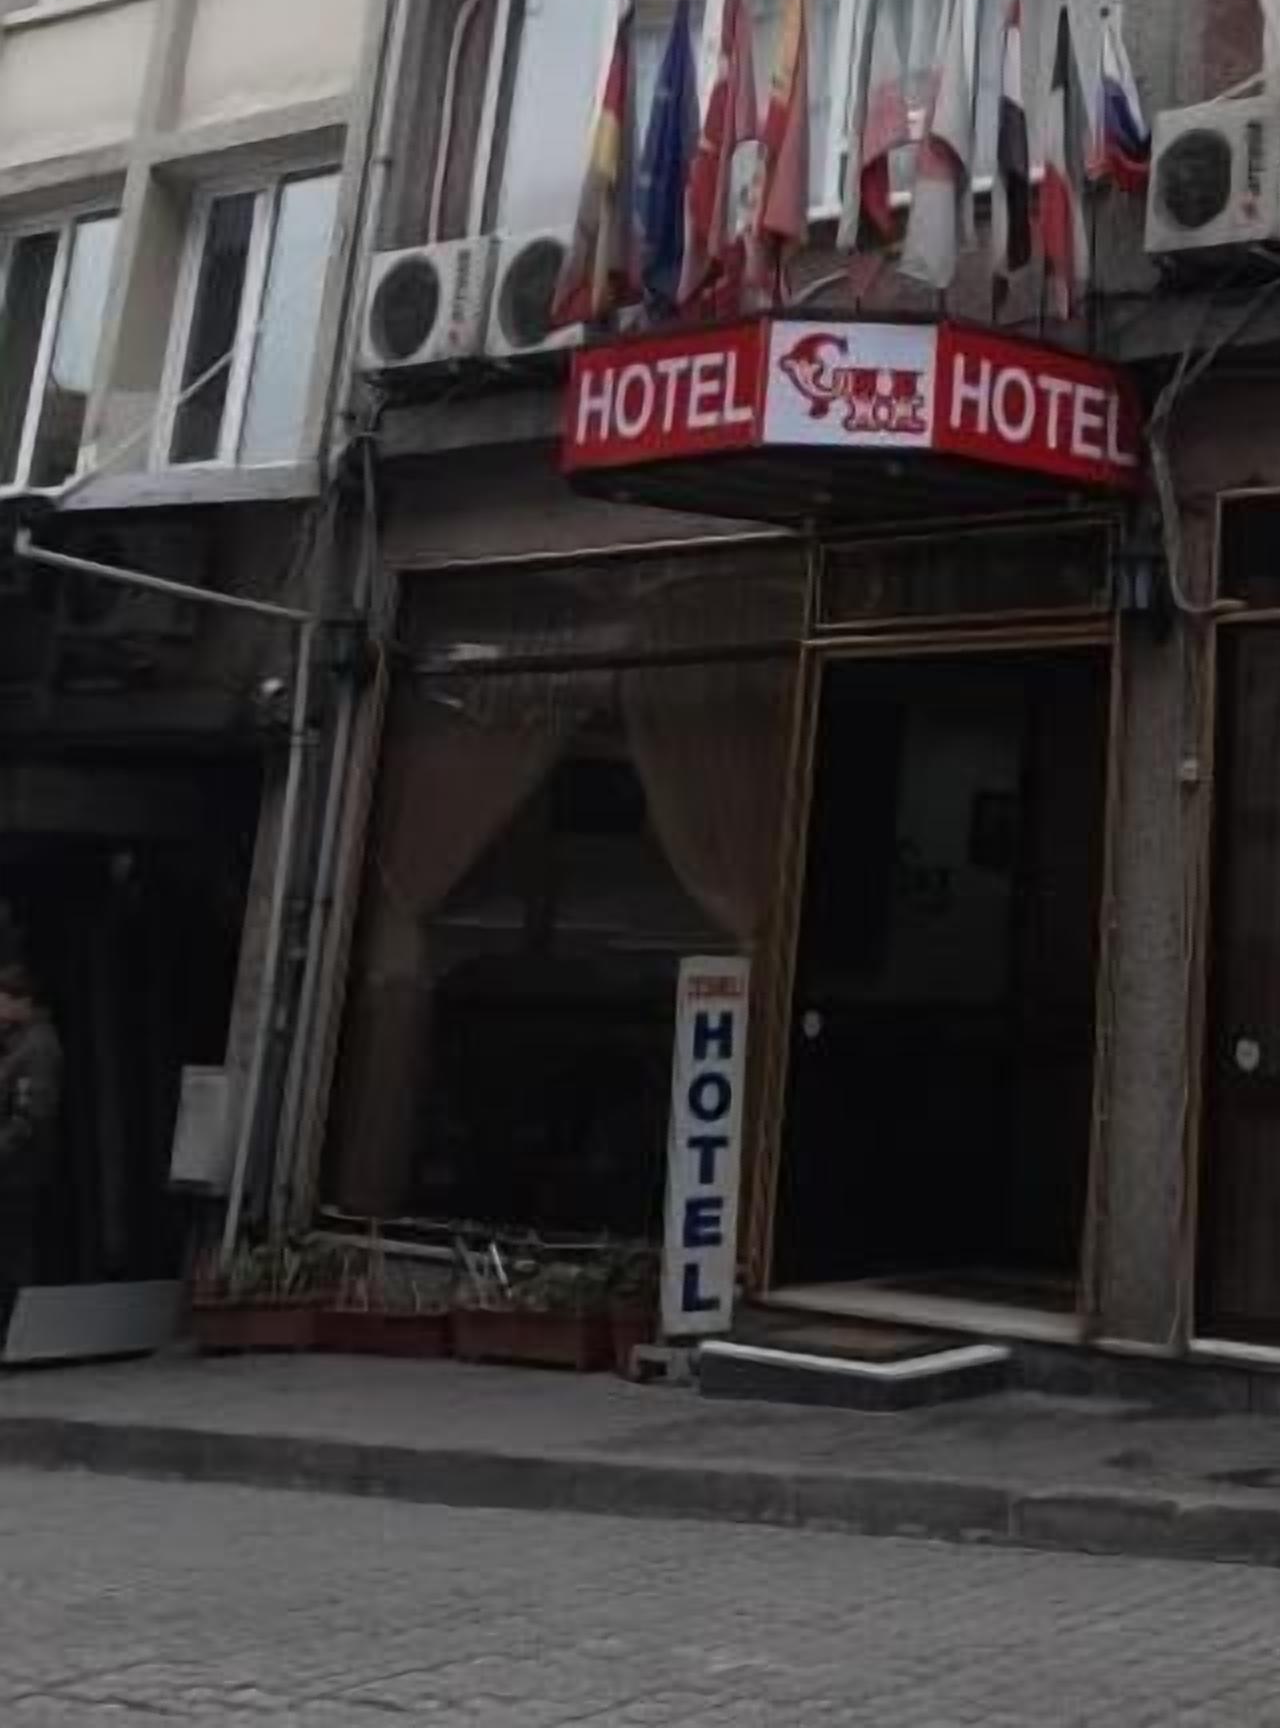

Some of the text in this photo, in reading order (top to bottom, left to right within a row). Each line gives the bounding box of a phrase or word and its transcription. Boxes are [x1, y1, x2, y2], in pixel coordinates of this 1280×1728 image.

[576, 350, 754, 445] HOTEL
[951, 352, 1137, 466] HOTEL
[682, 1009, 733, 1313] HOTEL
